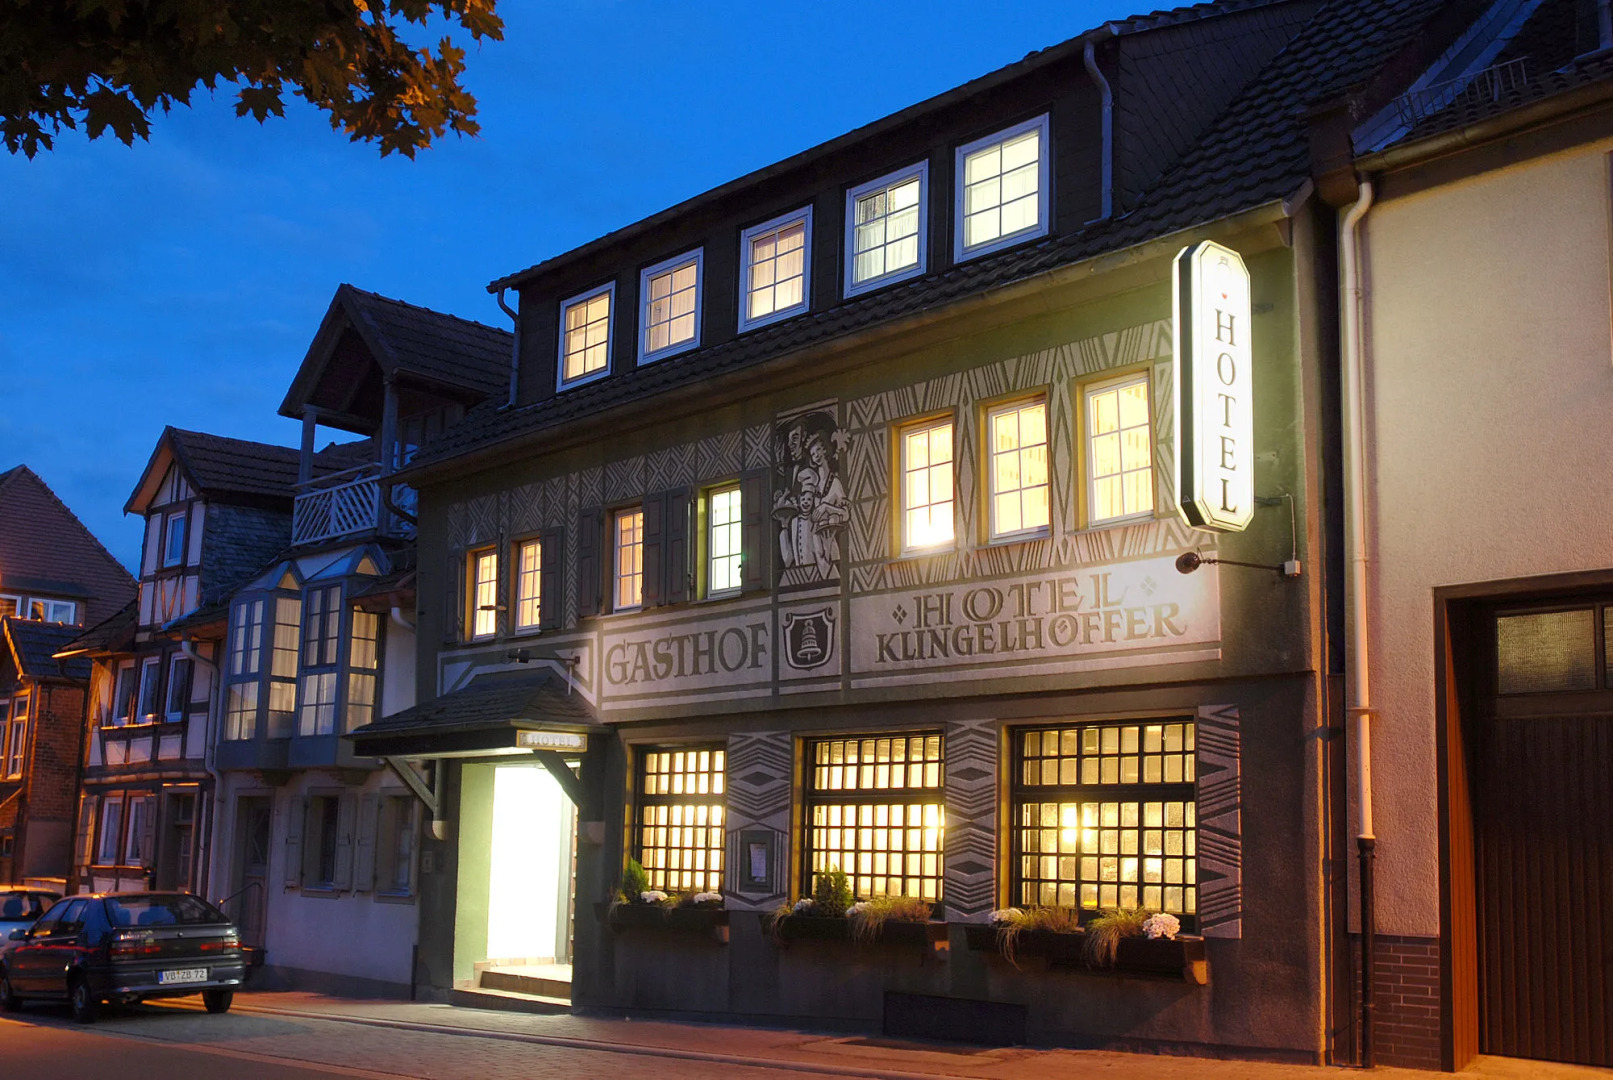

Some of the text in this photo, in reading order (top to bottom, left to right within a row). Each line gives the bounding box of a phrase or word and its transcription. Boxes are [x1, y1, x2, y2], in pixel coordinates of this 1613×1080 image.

[1215, 308, 1237, 514] HOTEL
[912, 572, 1128, 629] HOTEL
[605, 621, 769, 685] GASTHOF
[531, 734, 573, 747] HOTEL
[194, 970, 205, 978] 72
